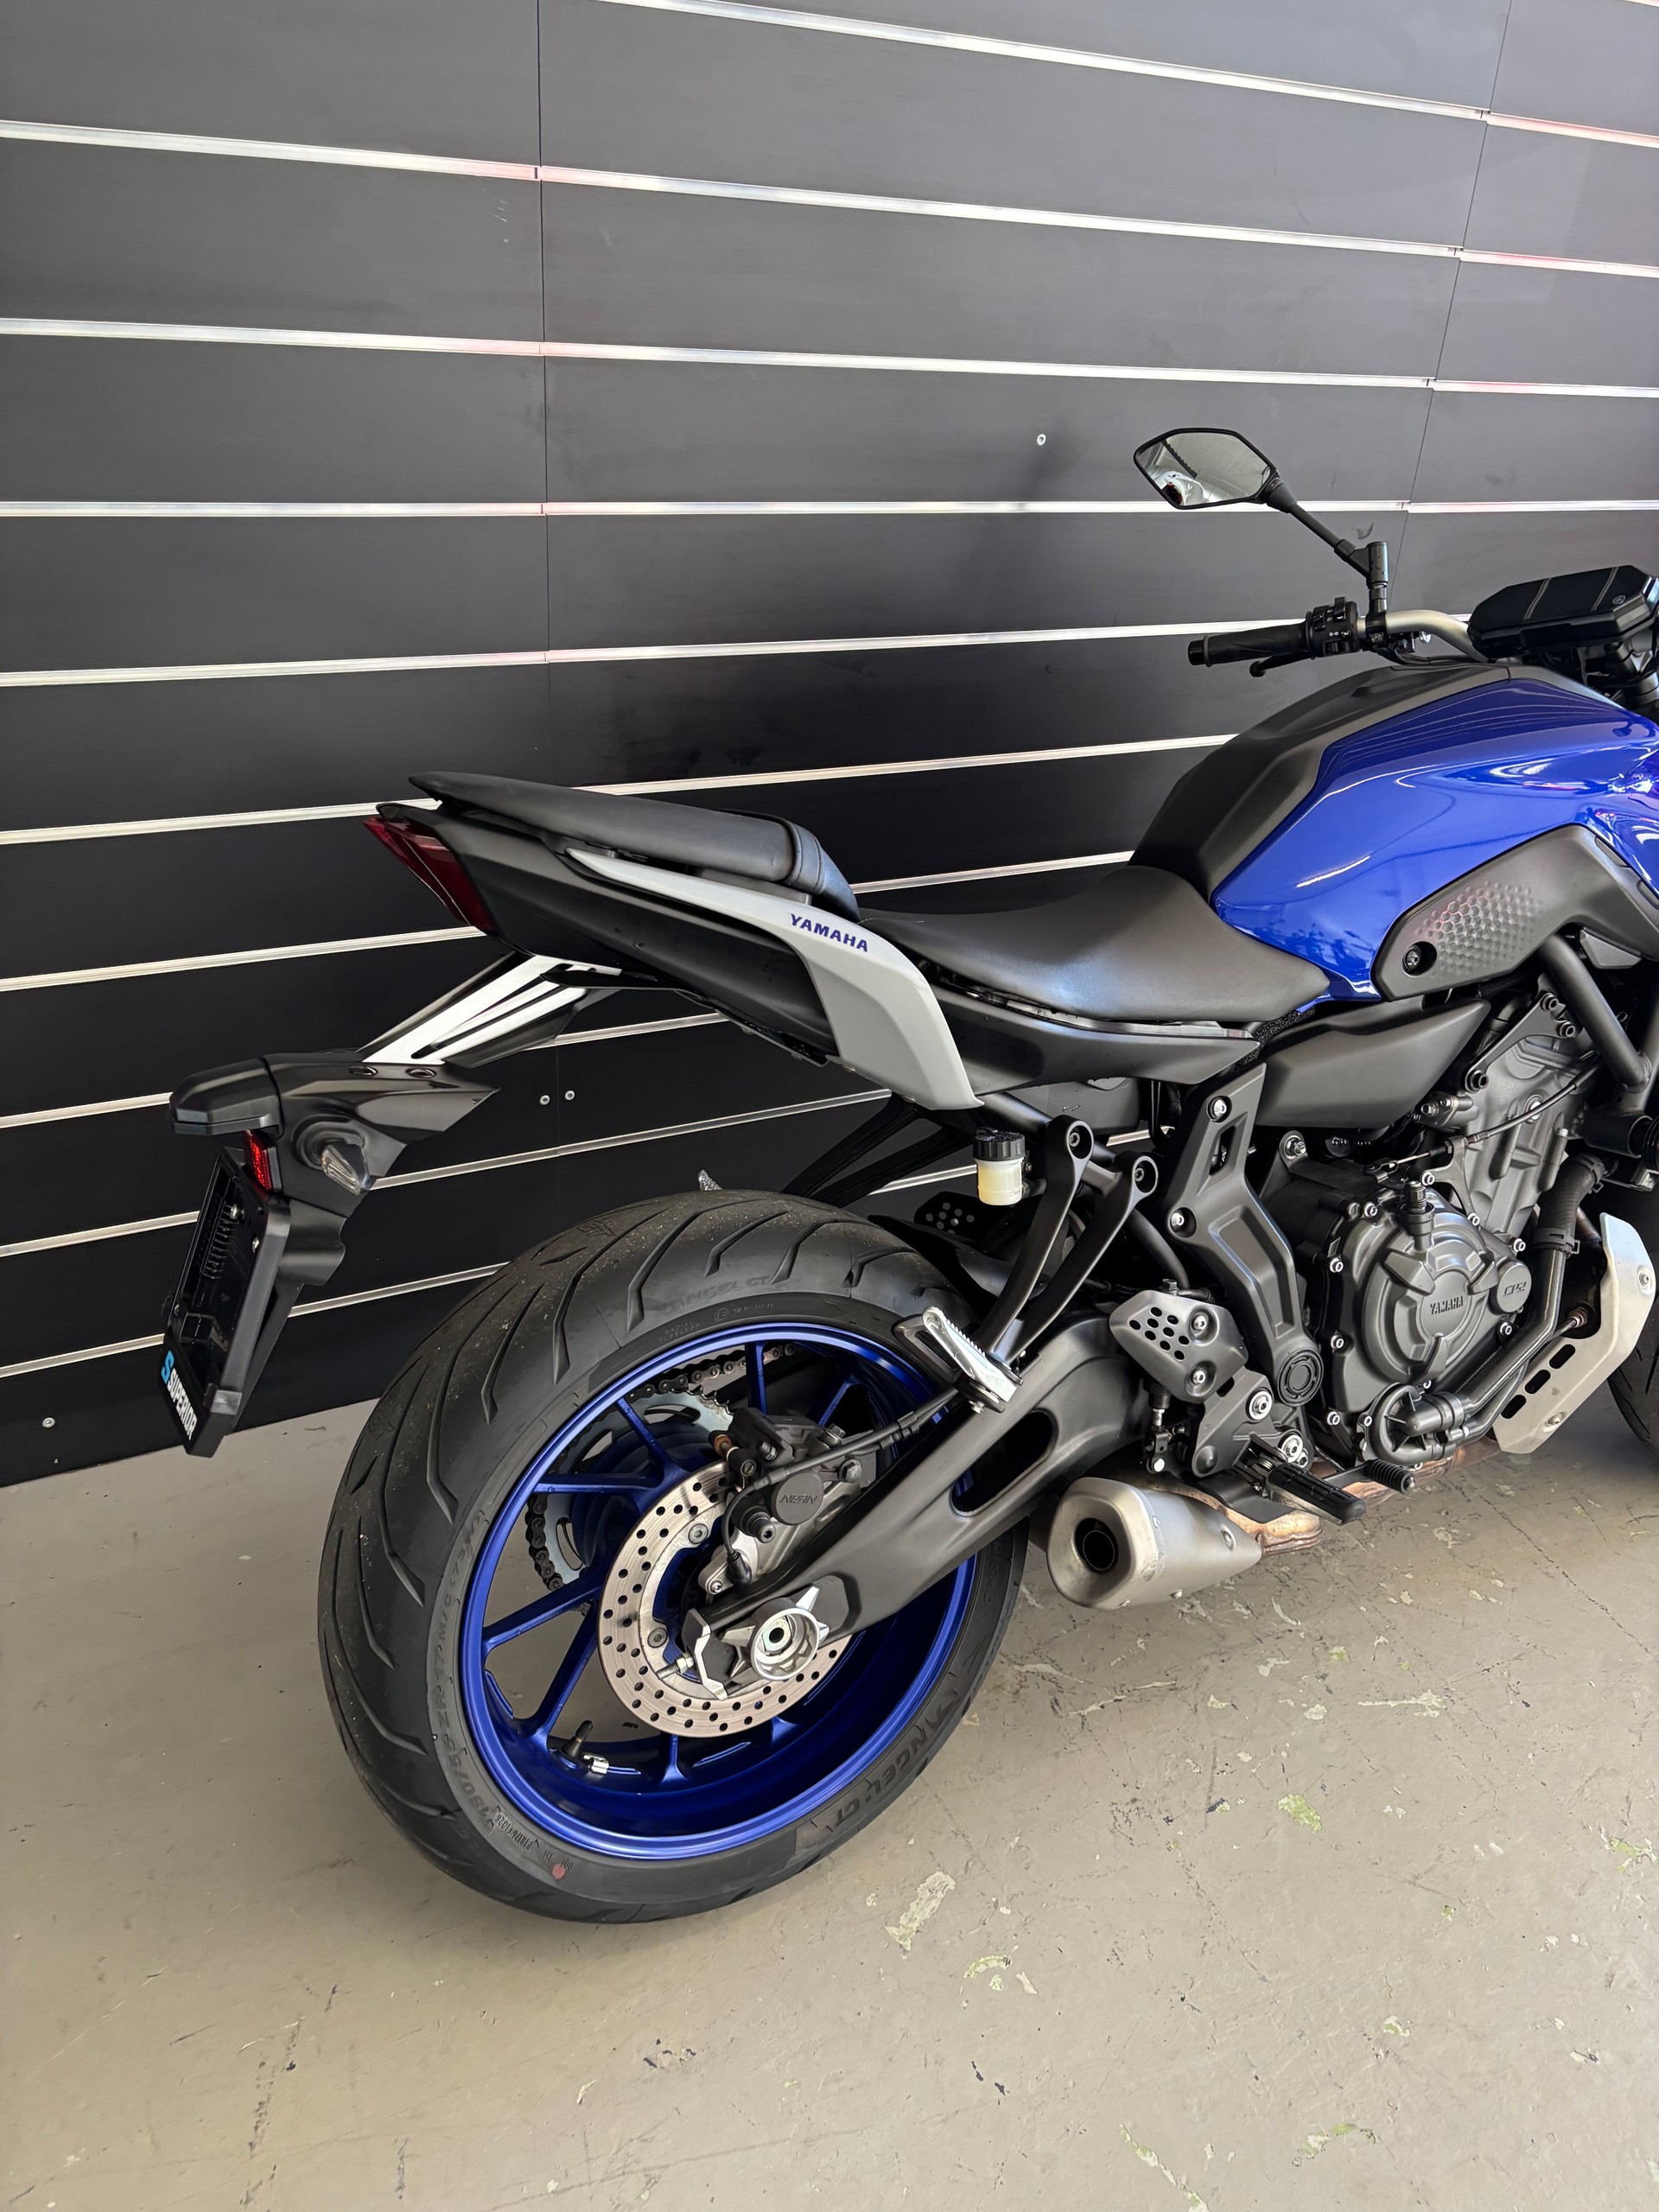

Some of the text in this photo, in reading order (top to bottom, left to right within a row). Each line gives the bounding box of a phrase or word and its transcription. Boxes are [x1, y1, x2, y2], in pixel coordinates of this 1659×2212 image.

[790, 913, 868, 953] YAMAHA
[1503, 1281, 1528, 1296] CP2
[1430, 1295, 1465, 1316] YAMAHA
[167, 1368, 198, 1441] SUPERIOR
[779, 1494, 818, 1505] NISSIN
[835, 1797, 861, 1828] GT
